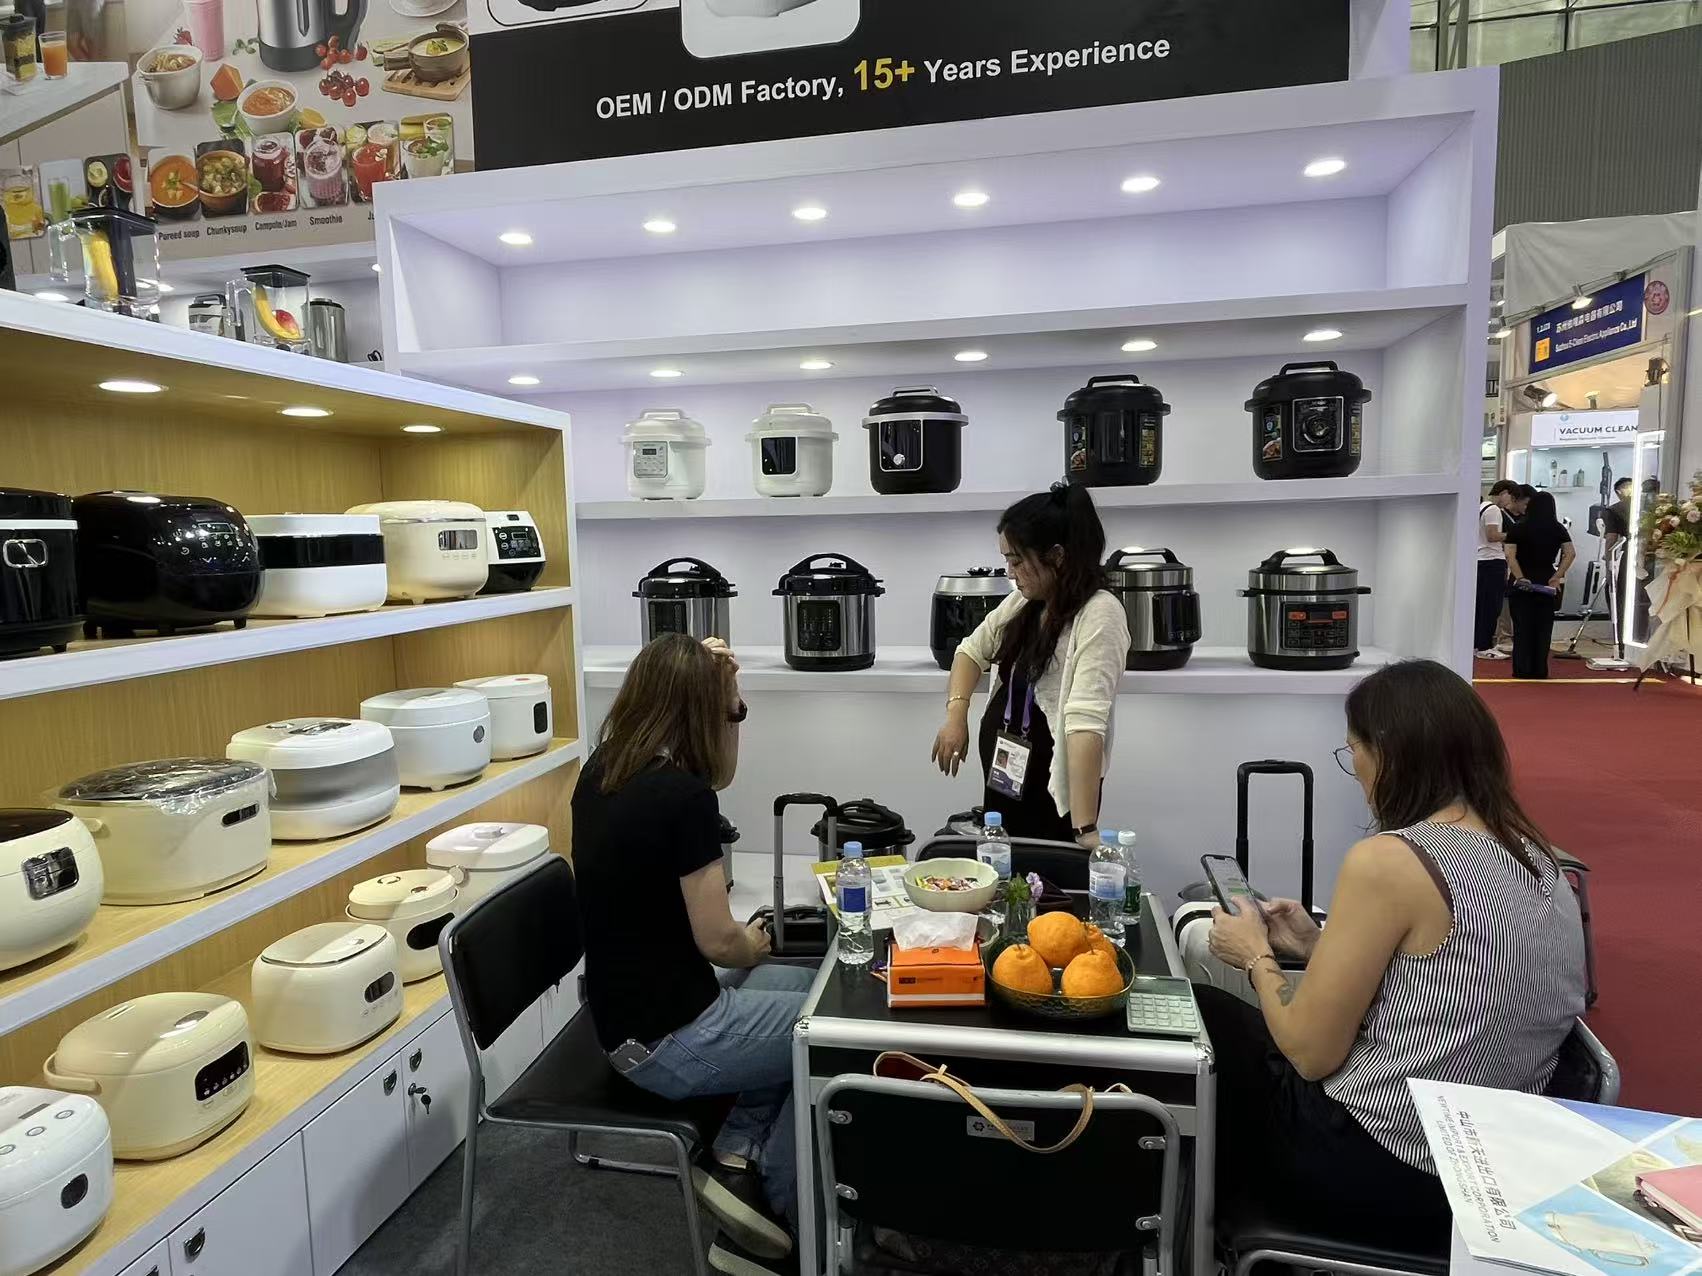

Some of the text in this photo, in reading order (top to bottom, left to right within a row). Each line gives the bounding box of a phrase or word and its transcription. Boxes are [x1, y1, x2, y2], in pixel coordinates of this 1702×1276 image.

[596, 38, 1171, 119] OEM / ODM Factory, 15+ Years Experience
[309, 215, 343, 225] Smoothie
[1560, 426, 1603, 434] VACUUM
